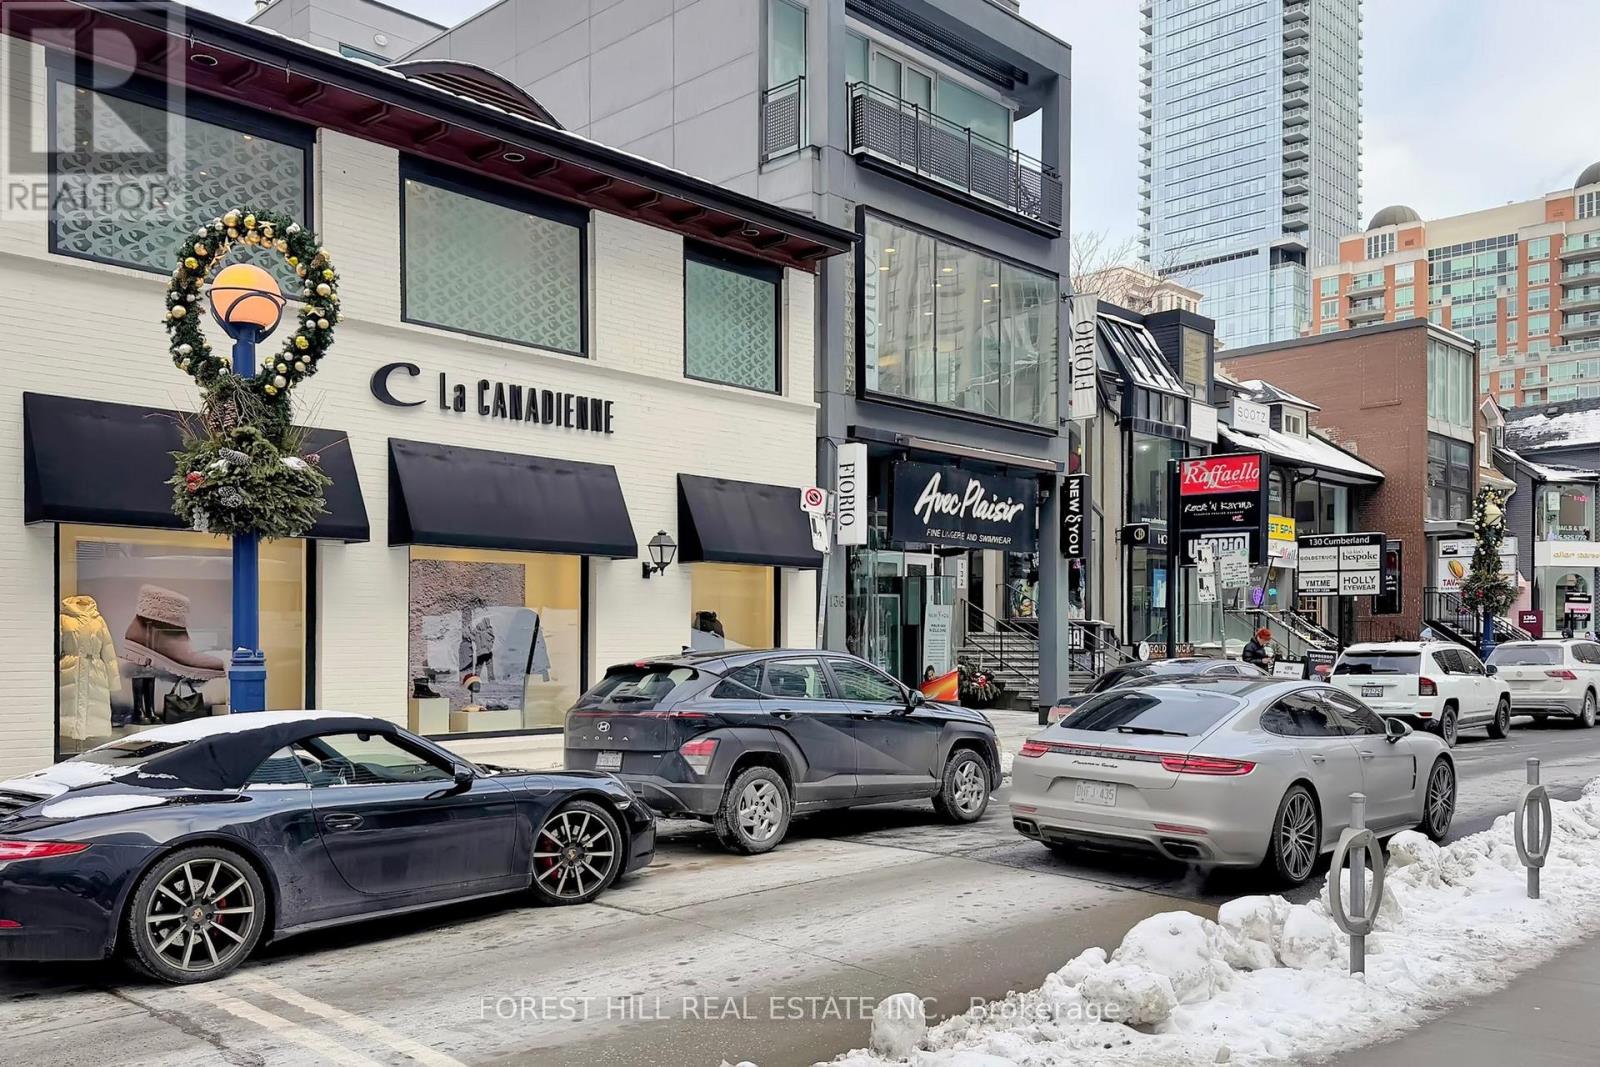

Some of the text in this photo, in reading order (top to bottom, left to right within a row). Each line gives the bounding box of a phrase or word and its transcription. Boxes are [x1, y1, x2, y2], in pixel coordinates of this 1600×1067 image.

[439, 372, 614, 434] La CANADIENNE
[1184, 462, 1260, 489] Raffaello
[913, 471, 1025, 524] Avec Plaisir
[1069, 479, 1080, 512] NEW
[926, 528, 941, 538] FINE
[966, 533, 978, 542] AND
[978, 534, 1012, 545] SWIMWEAR
[1068, 524, 1079, 554] YOU
[1280, 524, 1293, 534] SPA
[1309, 536, 1370, 546] 130 Cumberland
[1342, 551, 1378, 563] bespoke
[1343, 575, 1376, 584] HOLLY
